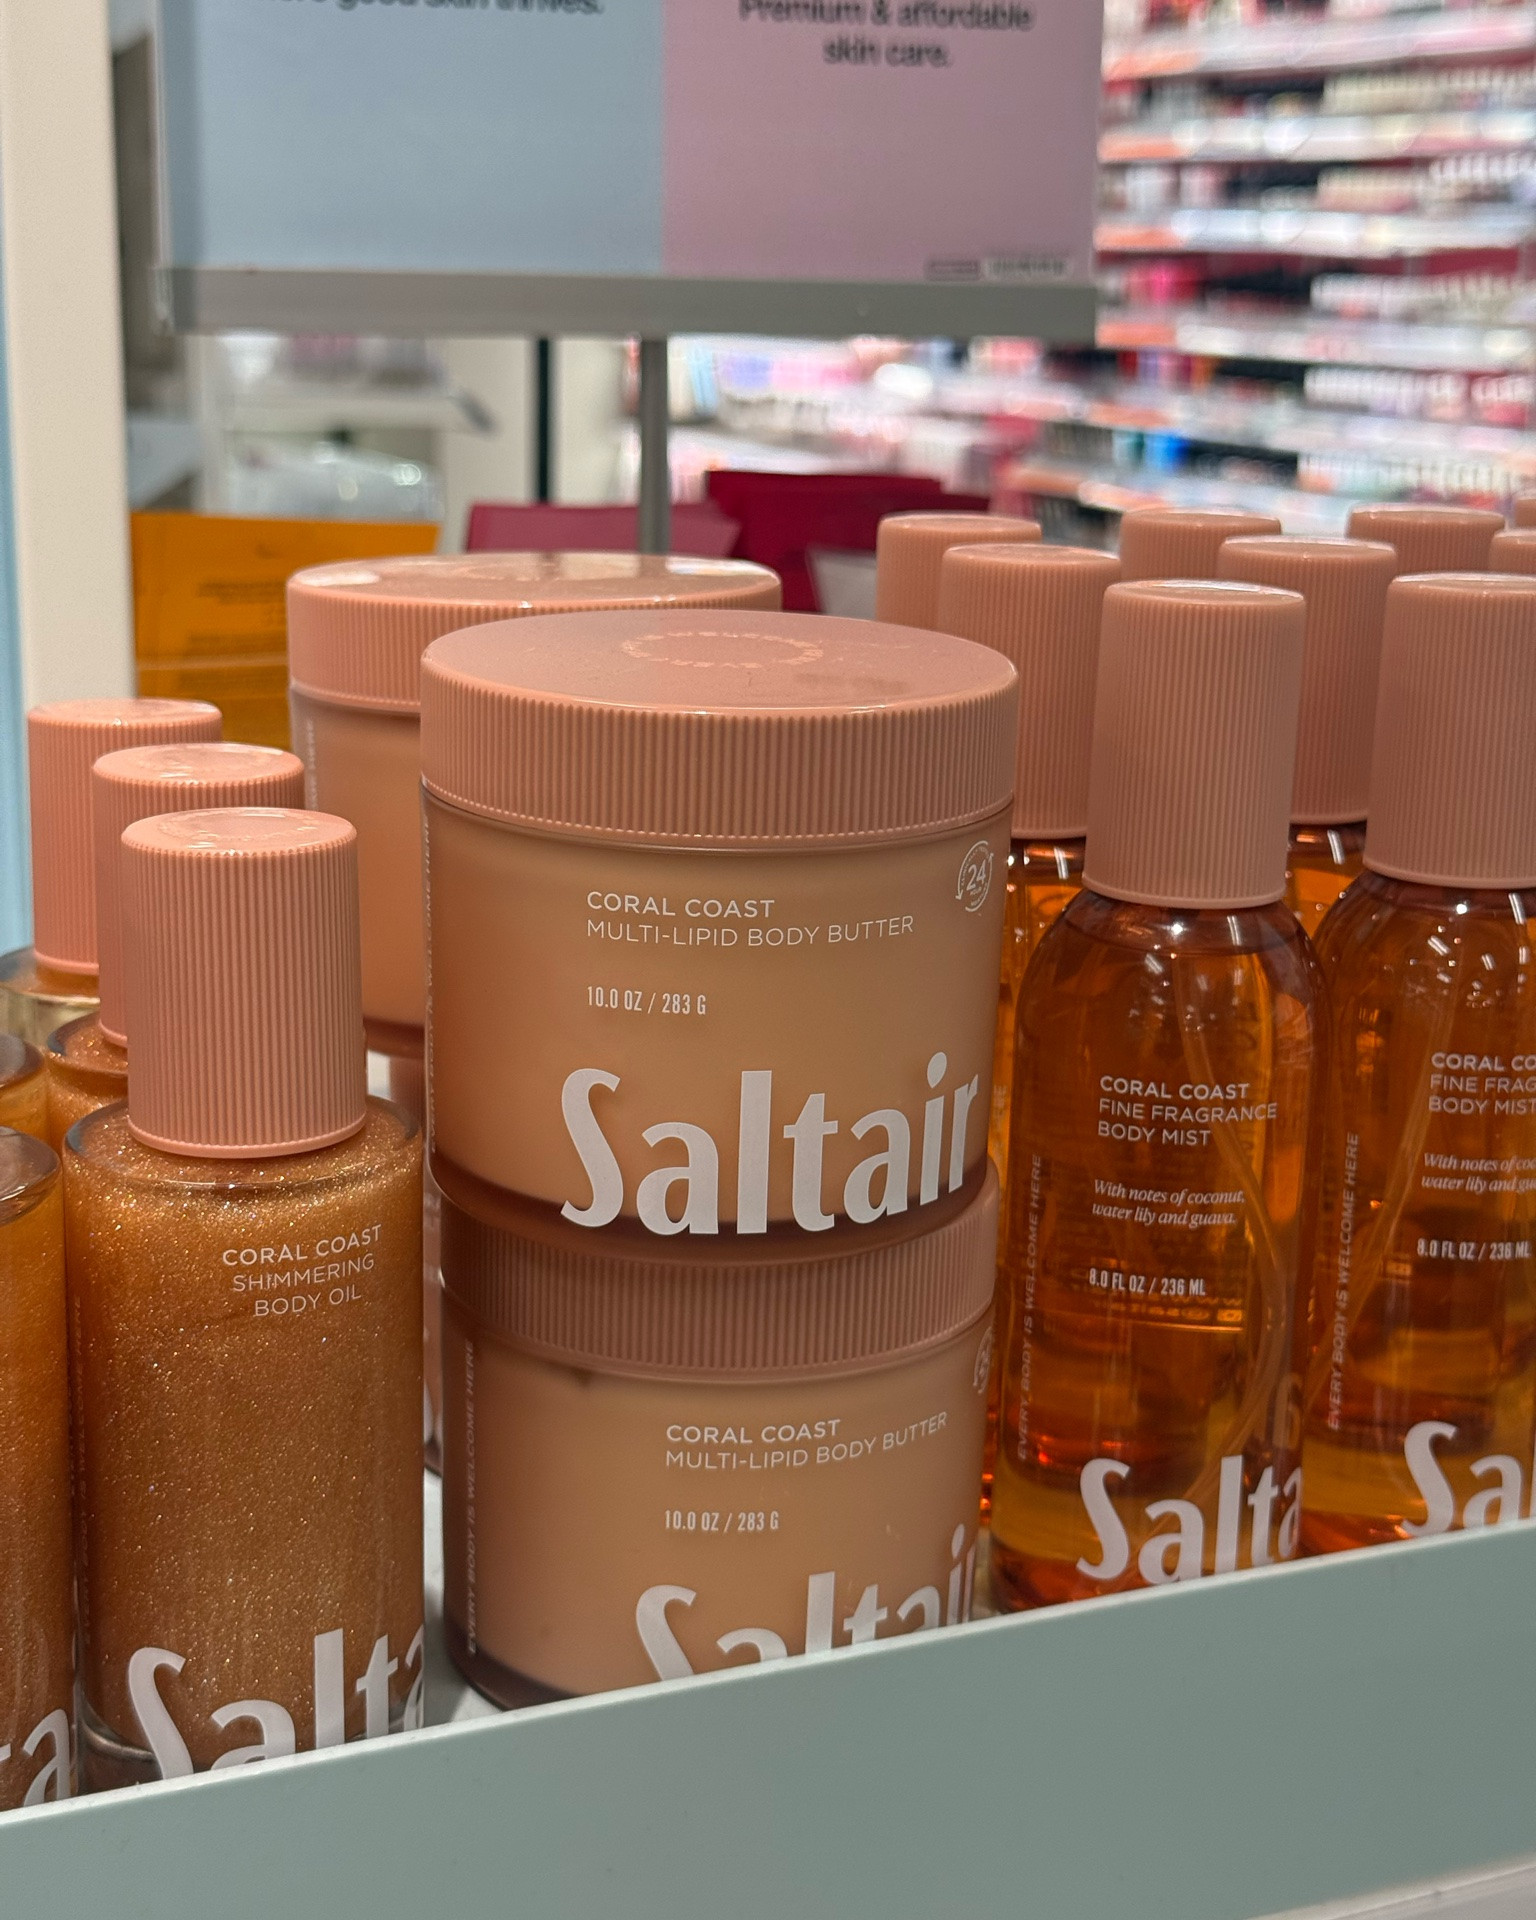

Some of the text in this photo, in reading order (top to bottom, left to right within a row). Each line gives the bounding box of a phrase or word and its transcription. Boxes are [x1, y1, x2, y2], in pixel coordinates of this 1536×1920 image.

[738, 0, 1034, 30] Premium & affordable
[823, 36, 952, 66] skin care.
[587, 891, 775, 918] CORAL COAST
[587, 915, 914, 946] MULTI-LIPID BODY BUTTER
[587, 986, 706, 1015] 10.0 OZ / 283 G
[1431, 1052, 1505, 1072] CORAL
[1100, 1075, 1249, 1100] CORAL COAST
[1430, 1073, 1478, 1093] FINE
[1099, 1098, 1278, 1124] FINE FRAGRANCE
[1428, 1095, 1488, 1115] BODY
[560, 1051, 978, 1236] Saltair
[1098, 1120, 1211, 1146] BODY MIST
[1423, 1152, 1457, 1171] With
[1460, 1157, 1498, 1172] notes
[1500, 1155, 1517, 1174] of
[1094, 1179, 1127, 1199] With
[1128, 1188, 1168, 1204] notes
[1169, 1188, 1188, 1207] of
[1421, 1175, 1464, 1191] water
[1465, 1176, 1487, 1195] lily
[1489, 1176, 1516, 1192] and
[1092, 1202, 1133, 1220] water
[1134, 1206, 1156, 1228] lily
[1158, 1210, 1188, 1226] and
[222, 1224, 382, 1266] CORAL COAST
[1441, 1239, 1455, 1260] FL
[1458, 1241, 1475, 1261] OZ
[1478, 1241, 1487, 1262] /
[1515, 1240, 1532, 1259] ML
[233, 1253, 374, 1292] SHIMMERING
[1089, 1268, 1206, 1296] 8.0 FL OZ / 236 ML
[254, 1284, 362, 1317] BODY OIL
[666, 1419, 841, 1444] CORAL COAST
[666, 1411, 947, 1469] MULTI-LIPID BODY BUTTER
[665, 1510, 779, 1534] 10.0 OZ / 283 G
